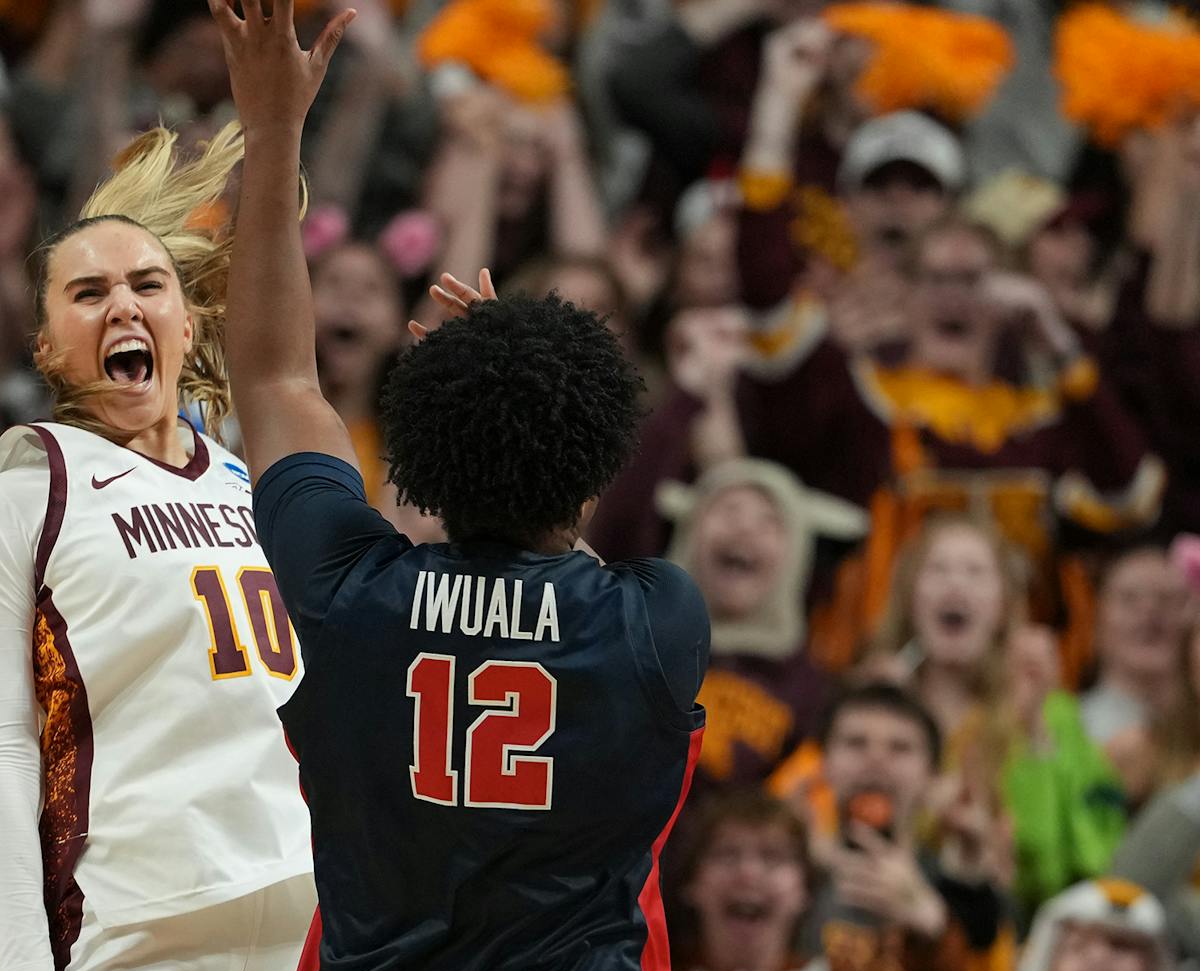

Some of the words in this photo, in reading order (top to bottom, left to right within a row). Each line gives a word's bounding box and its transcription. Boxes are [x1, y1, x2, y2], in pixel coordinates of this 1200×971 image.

[189, 565, 298, 681] 10
[409, 570, 560, 642] IWUALA
[406, 651, 558, 811] 12
